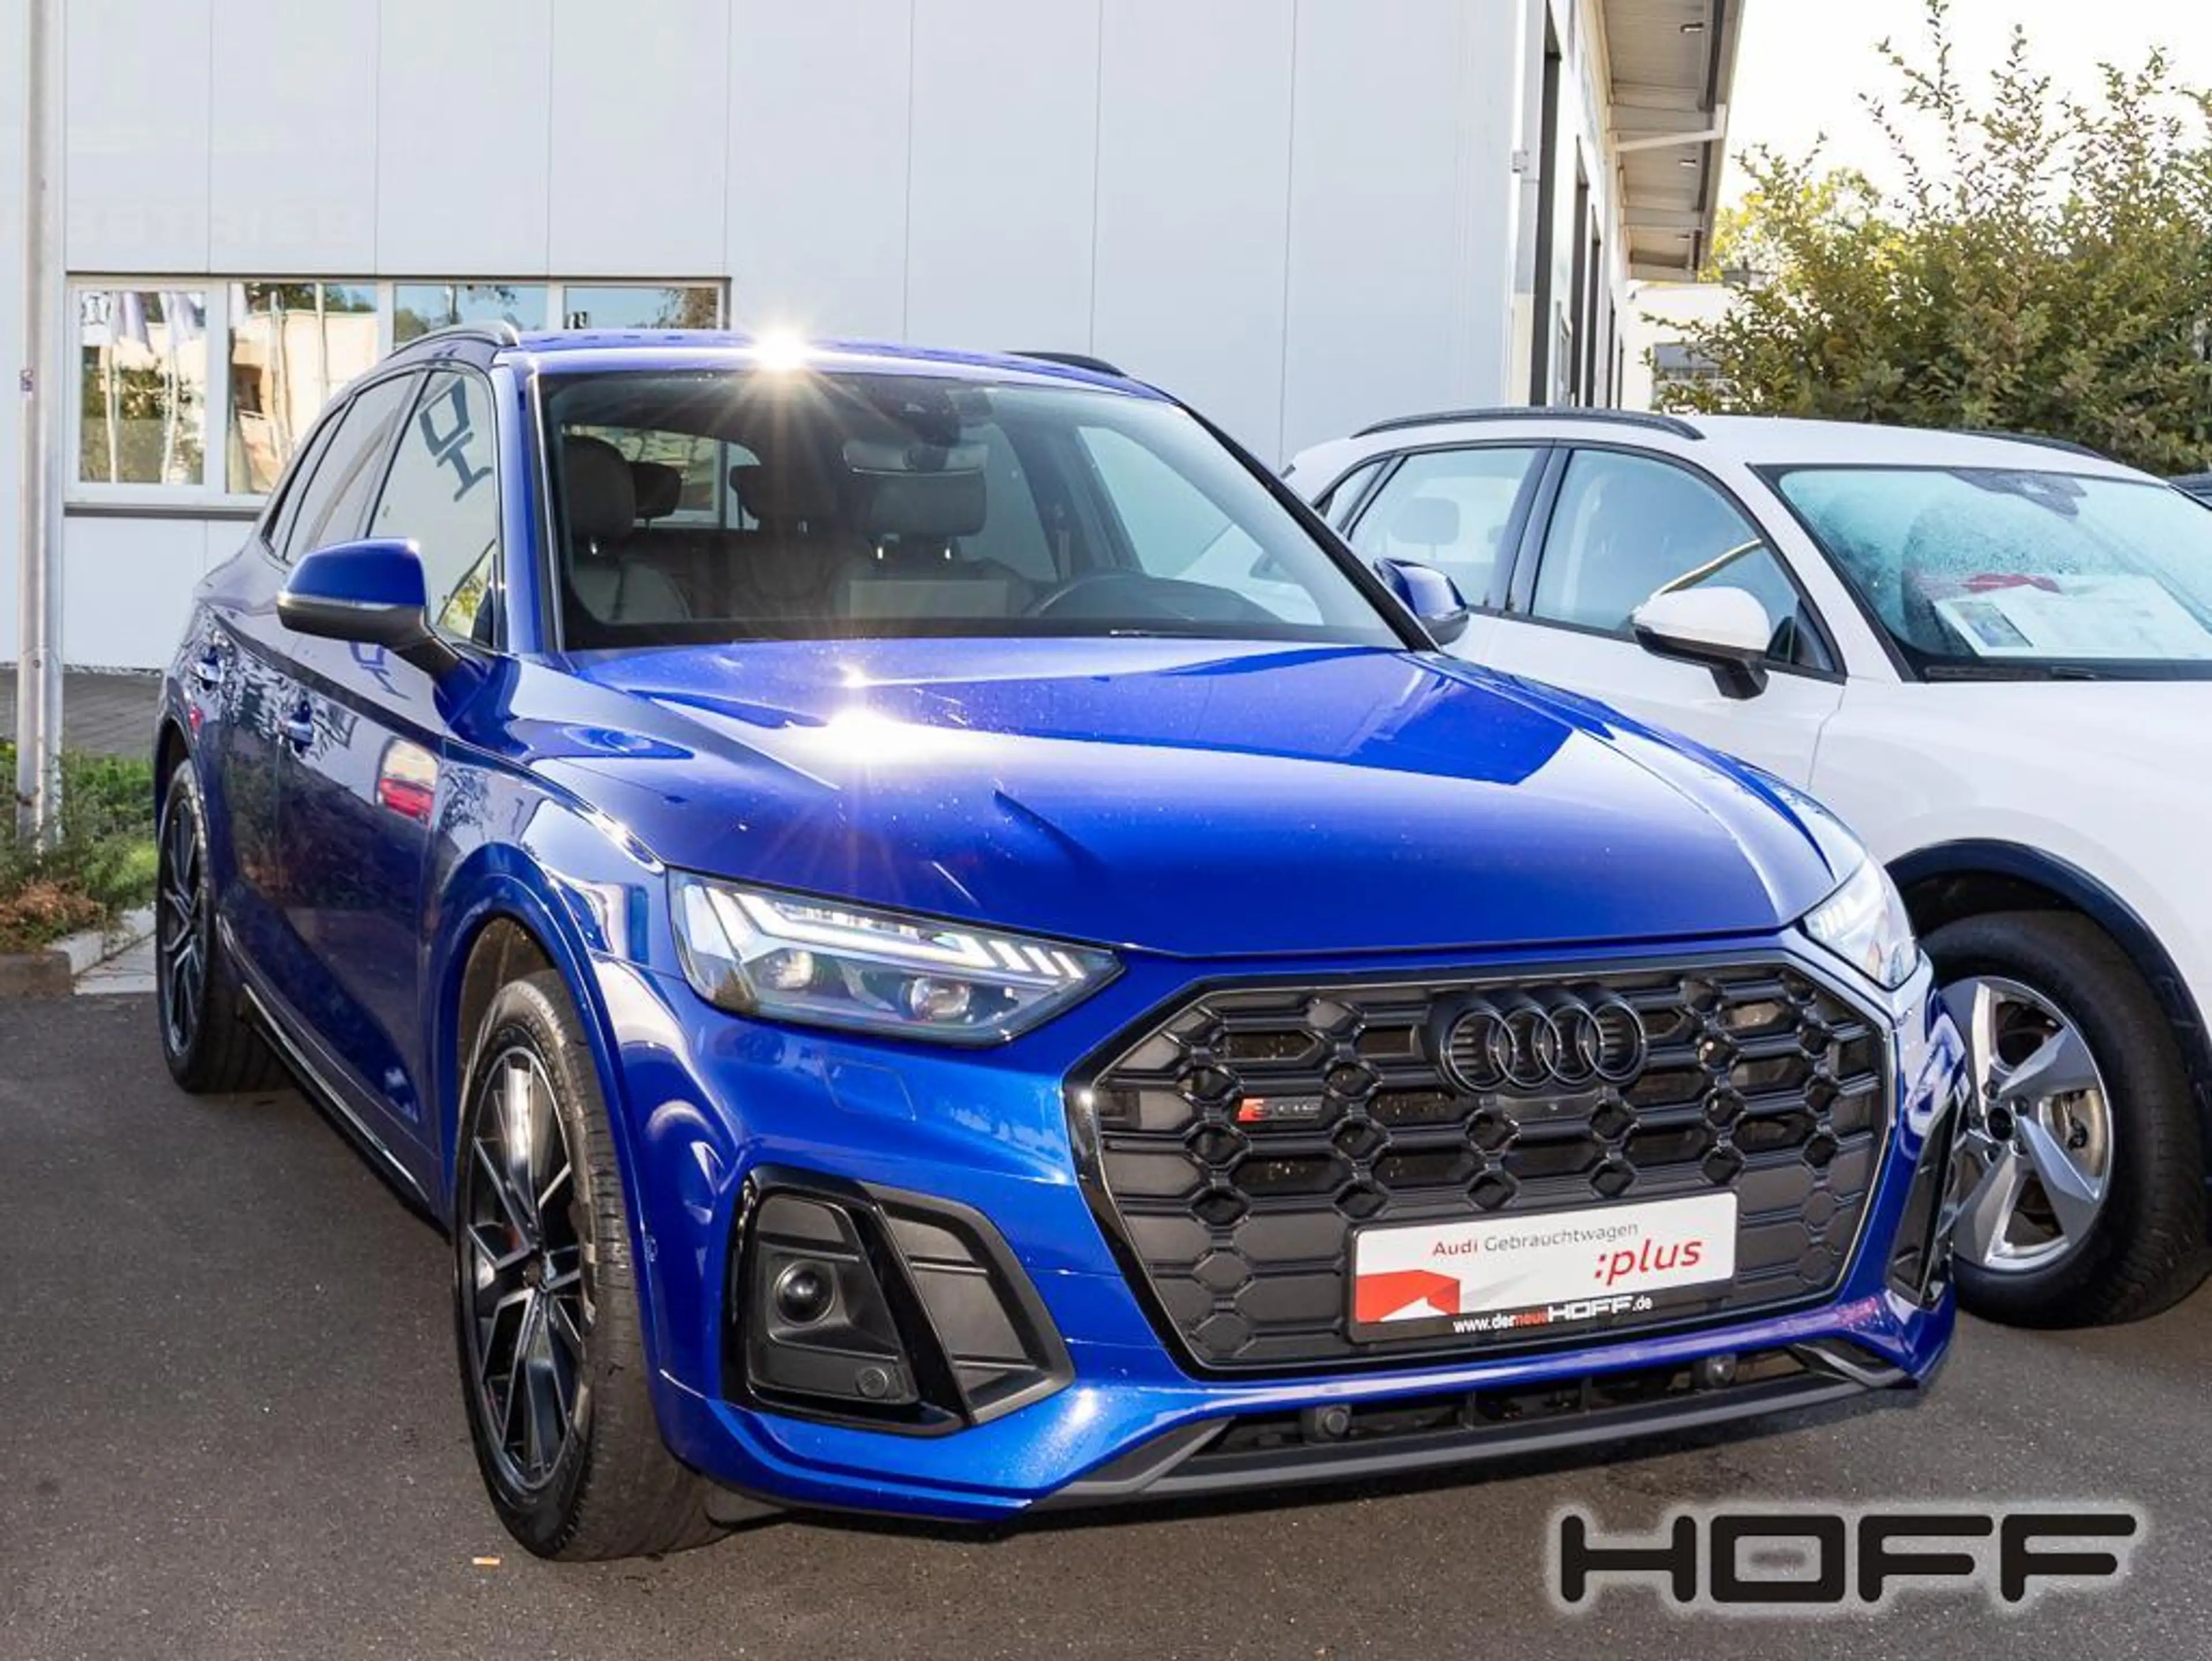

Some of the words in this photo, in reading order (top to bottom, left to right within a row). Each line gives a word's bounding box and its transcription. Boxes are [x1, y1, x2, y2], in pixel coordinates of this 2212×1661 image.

[1432, 1239, 1478, 1256] Audi
[1484, 1223, 1639, 1252] Gebrauchtwagen
[1594, 1238, 1702, 1286] :plus
